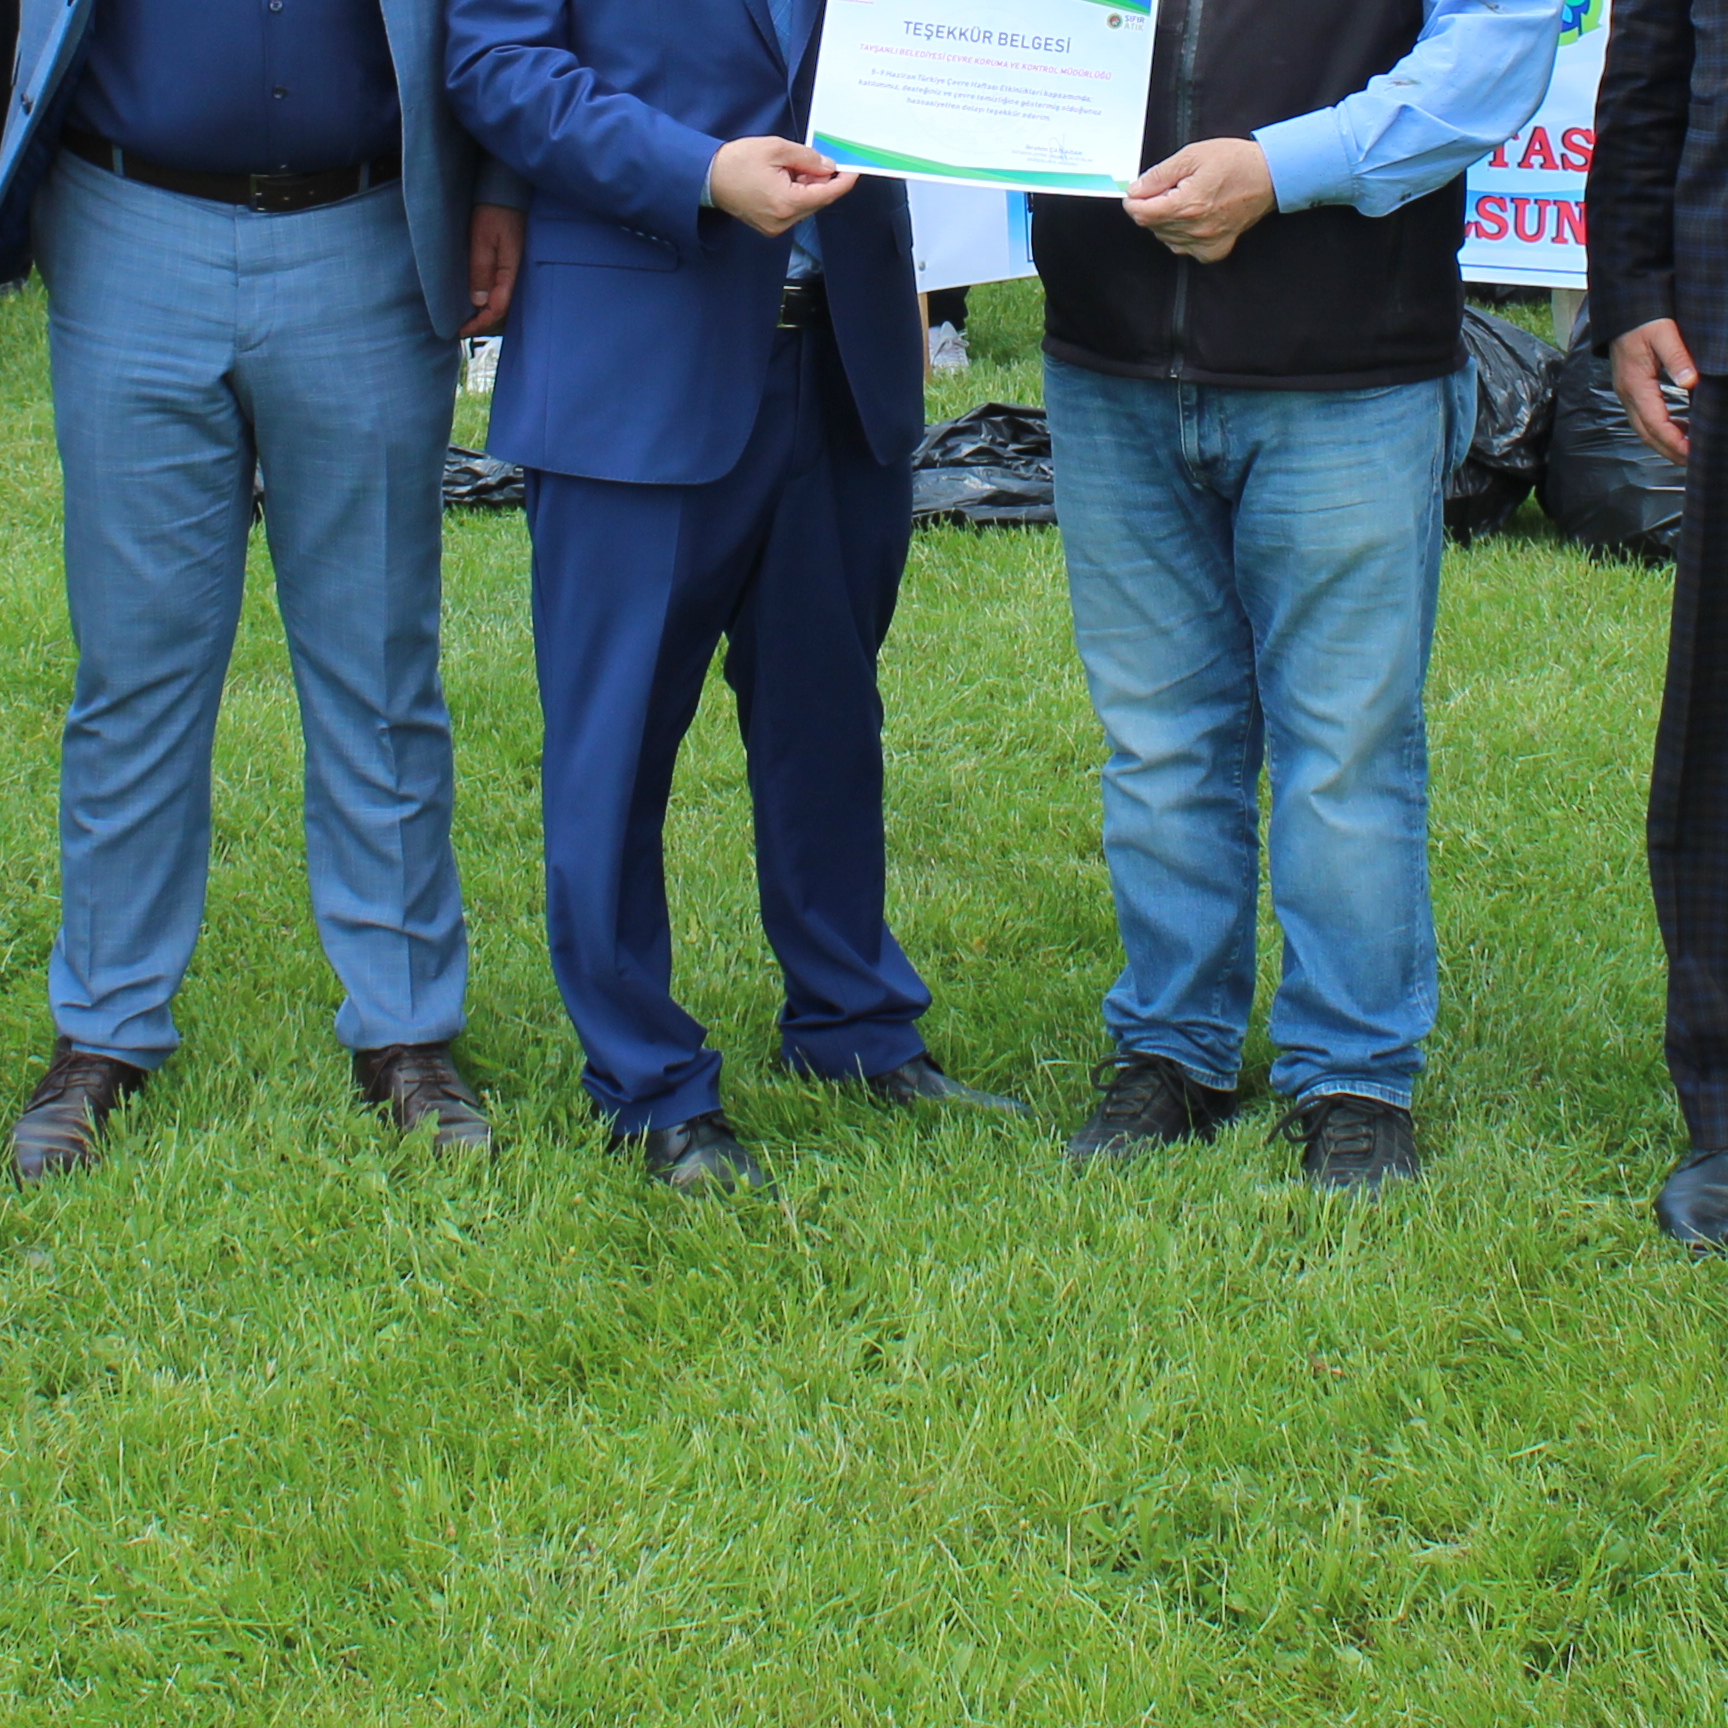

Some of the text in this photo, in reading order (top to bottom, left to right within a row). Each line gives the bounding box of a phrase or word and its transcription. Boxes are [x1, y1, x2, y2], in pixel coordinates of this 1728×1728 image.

[1124, 15, 1146, 24] SIFIR
[1124, 23, 1144, 31] ATIK
[903, 20, 1071, 54] TEŞEKKÜR BELGESİ
[860, 43, 898, 54] TAVŞANLI
[899, 48, 946, 60] BELEDİYESİ
[946, 54, 973, 64] ÇEVRE
[974, 57, 1008, 68] KORUMA
[1021, 63, 1059, 75] KONTROL
[1060, 68, 1112, 80] MÜDÜRLÜĞÜ
[917, 73, 945, 85] Türkiye
[947, 78, 970, 88] Çevre
